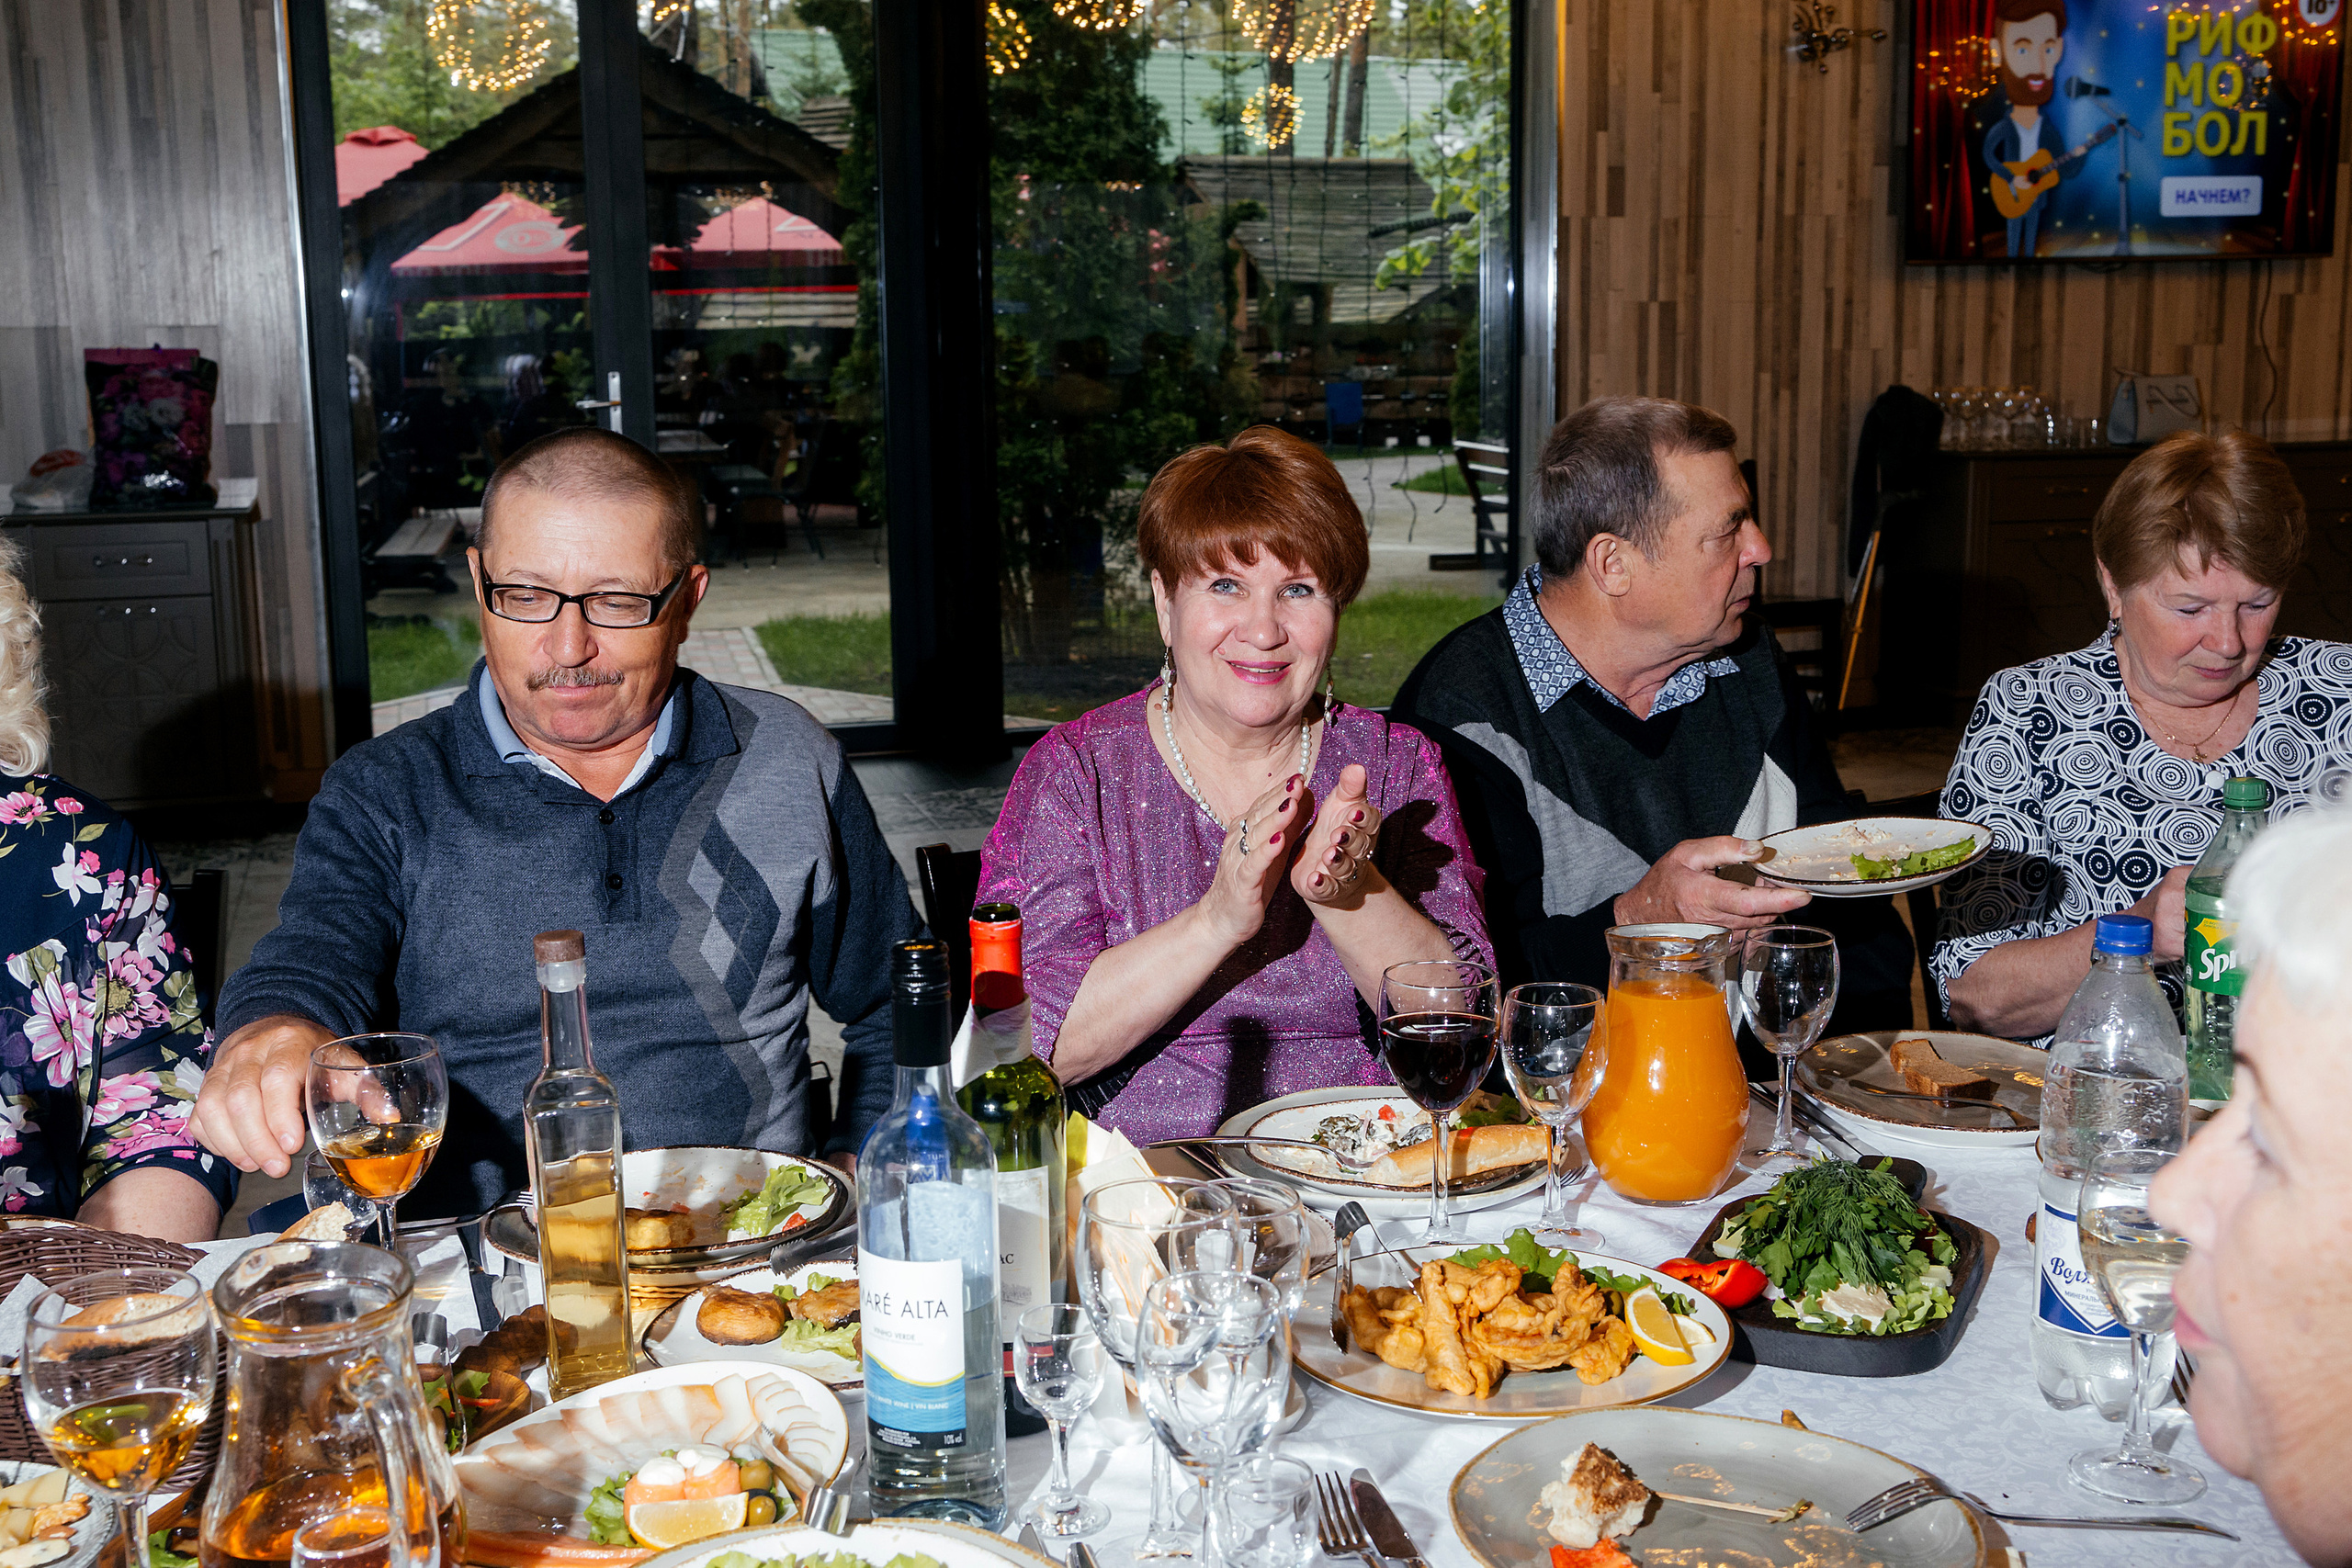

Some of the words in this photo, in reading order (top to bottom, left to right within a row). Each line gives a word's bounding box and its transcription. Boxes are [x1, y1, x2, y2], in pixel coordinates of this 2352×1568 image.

[2166, 11, 2277, 57] РИФ
[2165, 62, 2244, 107] МО
[2163, 111, 2267, 156] БОЛ
[2175, 188, 2250, 204] НАЧНЕМ?
[2199, 948, 2240, 982] Spr
[901, 1299, 948, 1319] ALTA
